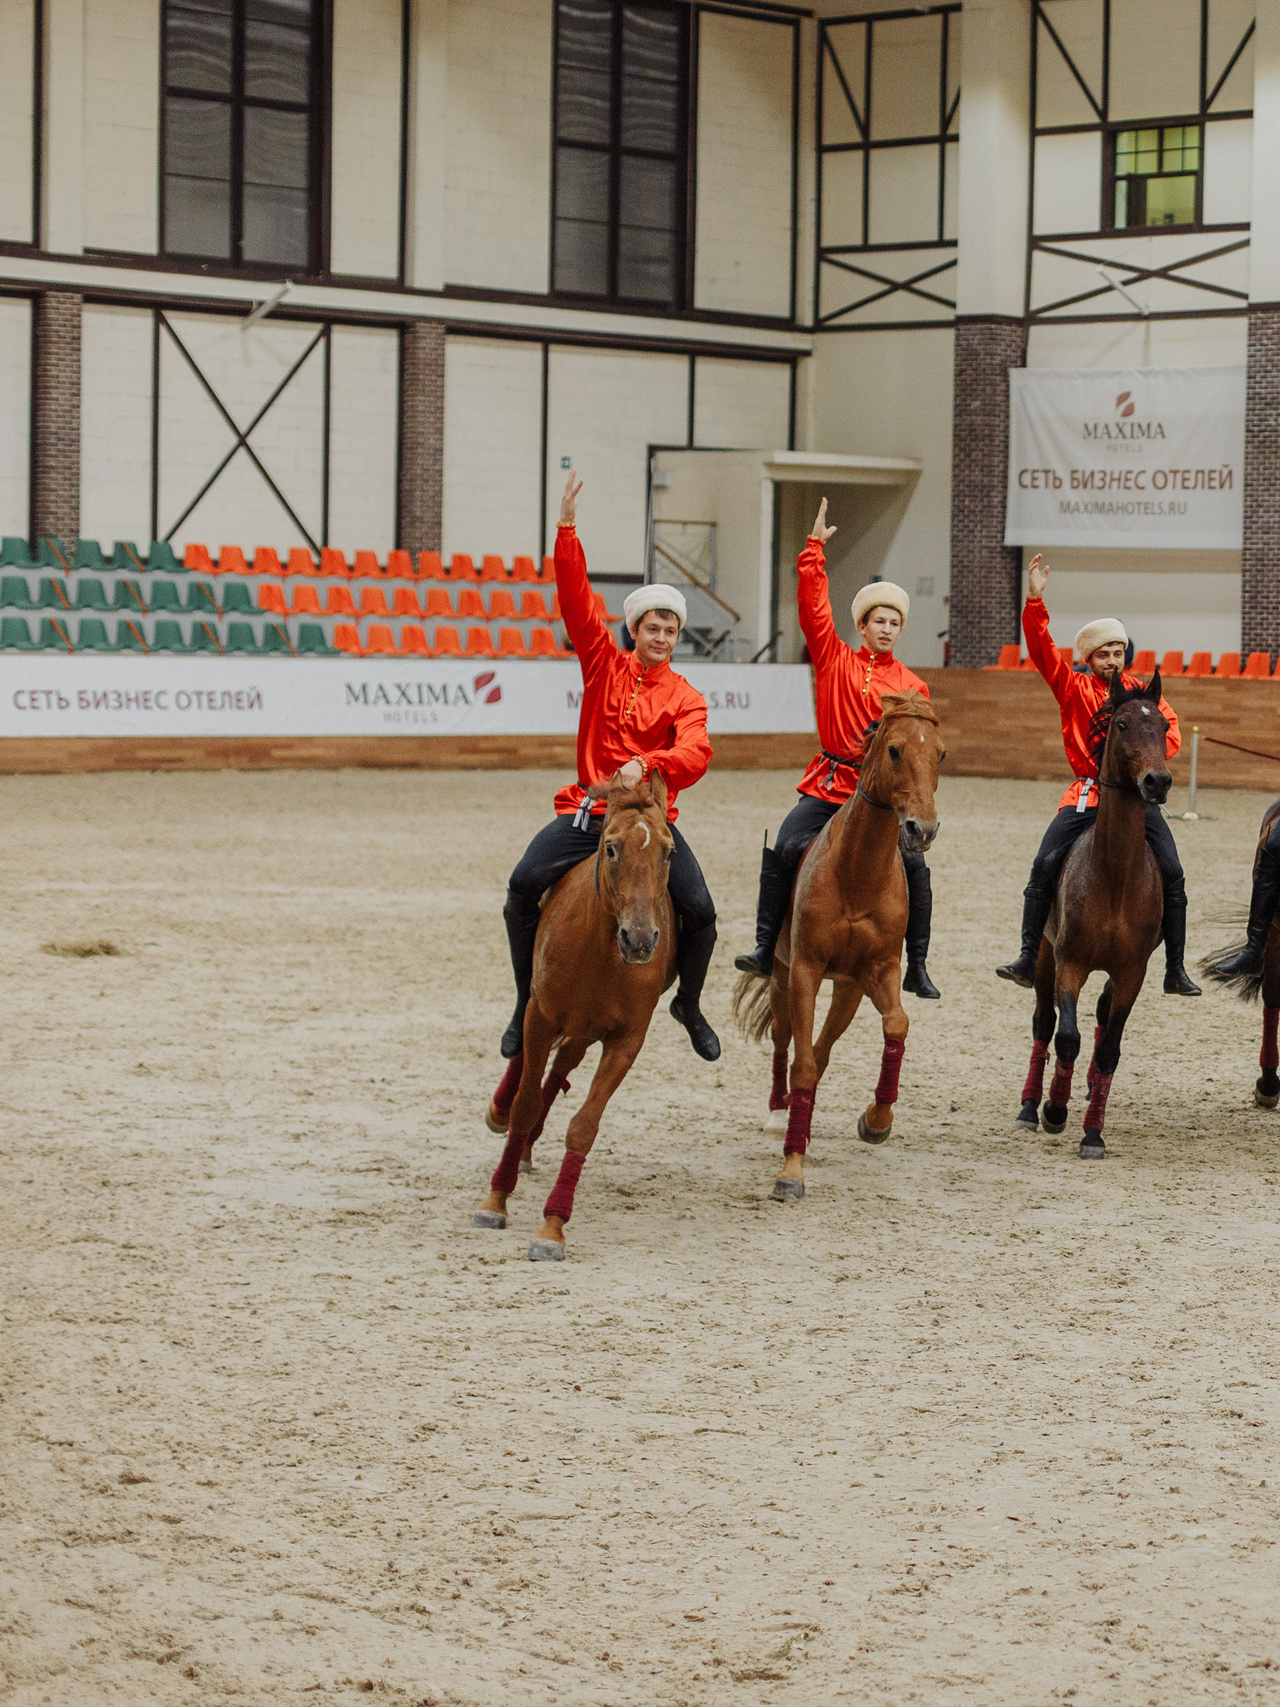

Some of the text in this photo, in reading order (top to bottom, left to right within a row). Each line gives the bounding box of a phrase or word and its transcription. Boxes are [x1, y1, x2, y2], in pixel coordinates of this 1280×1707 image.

[1083, 422, 1166, 440] MAXIMA
[1105, 443, 1142, 452] HOTELS
[1018, 464, 1233, 490] СЕТЬ БИЗНЕС ОТЕЛЕЙ
[1059, 501, 1187, 516] MAXIMAHOTELS.RU
[13, 685, 264, 711] СЕТЬ БИЗНЕС ОТЕЛЕЙ
[344, 681, 473, 706] MAXIMA
[383, 710, 439, 724] HOTELS
